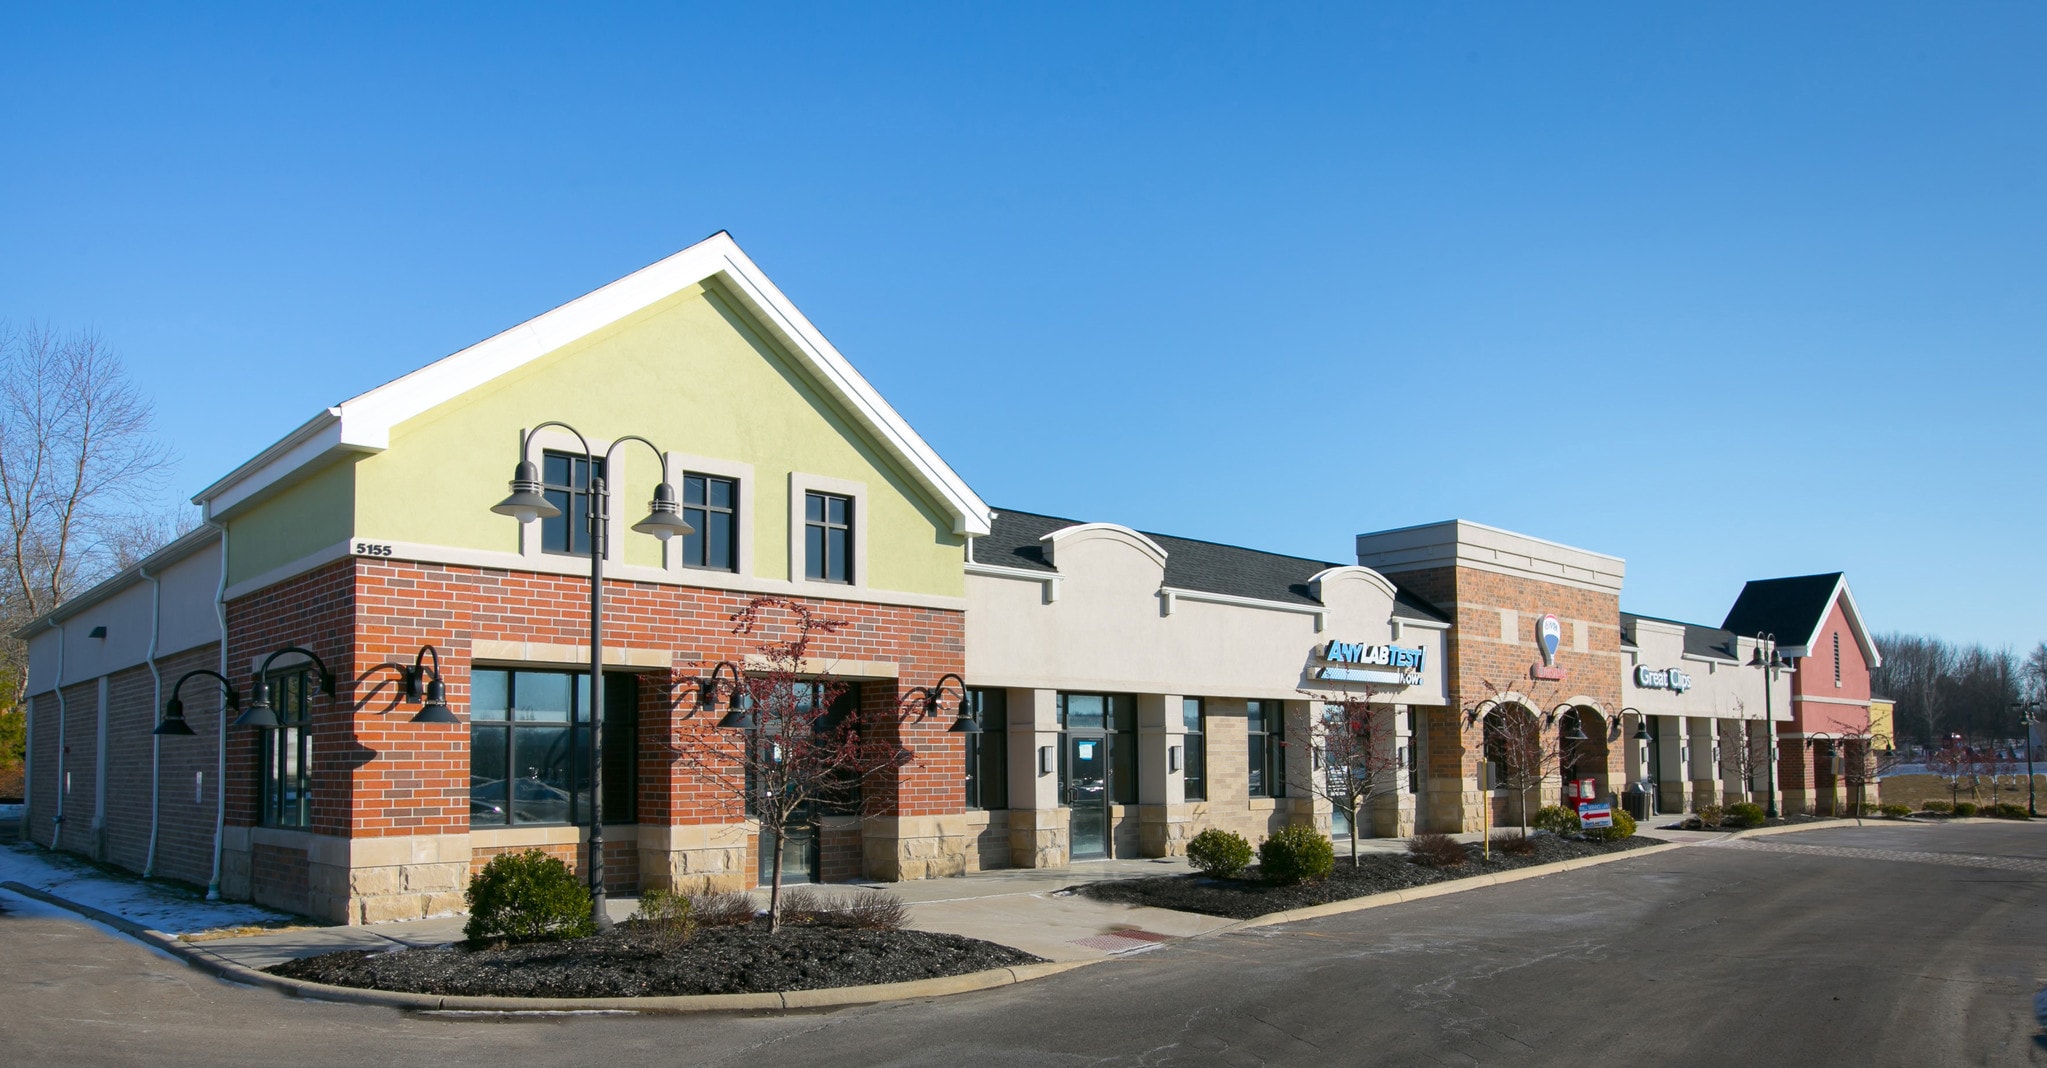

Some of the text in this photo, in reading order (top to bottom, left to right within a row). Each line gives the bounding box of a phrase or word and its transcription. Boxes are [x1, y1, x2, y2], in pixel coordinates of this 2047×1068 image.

[356, 543, 392, 556] 5155
[1639, 665, 1691, 693] Great Clips
